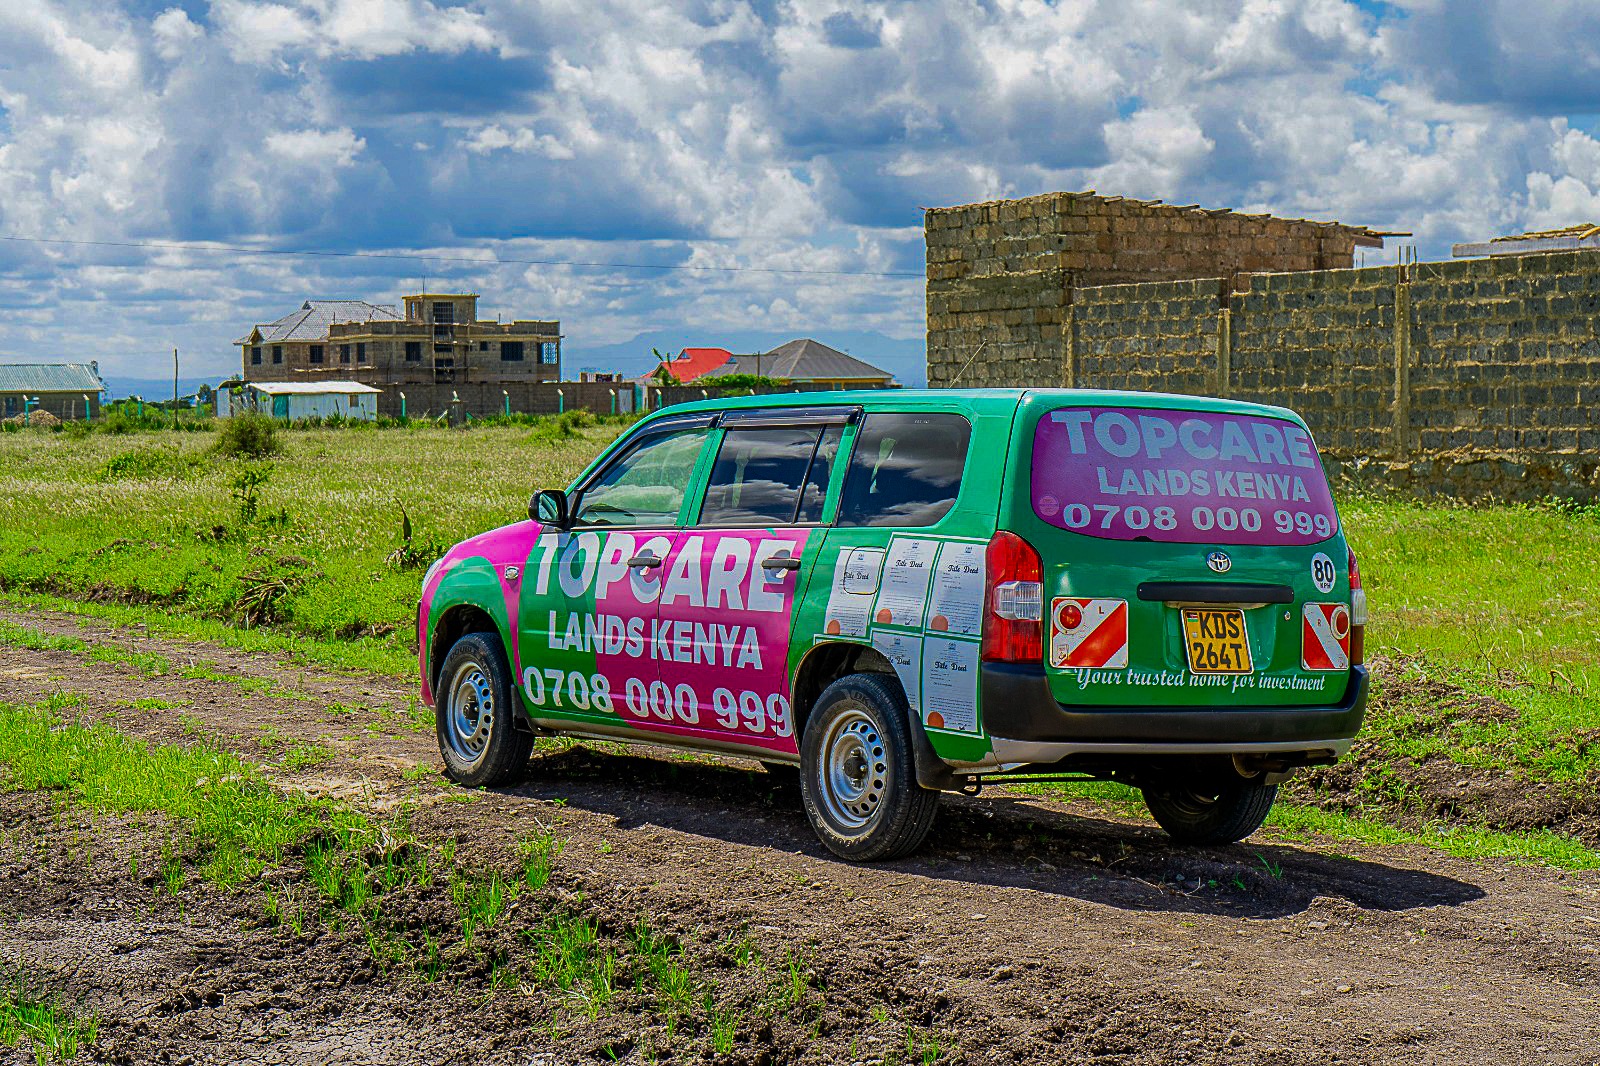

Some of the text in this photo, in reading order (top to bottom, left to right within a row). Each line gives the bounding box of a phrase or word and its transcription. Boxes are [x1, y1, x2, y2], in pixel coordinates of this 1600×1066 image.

[1050, 410, 1315, 469] TOPCARE
[1096, 466, 1311, 503] LANDS KENYA
[1063, 503, 1178, 530] 0708
[1191, 507, 1262, 532] 000
[1273, 510, 1331, 537] 999
[535, 531, 797, 613] TOPCARE
[1313, 559, 1334, 583] 80
[548, 610, 763, 670] LANDS KENYA
[1198, 612, 1241, 639] KDS
[1193, 642, 1243, 669] 264T
[1074, 668, 1122, 690] Your
[1126, 668, 1186, 687] trusted
[1231, 674, 1256, 694] for
[1258, 671, 1326, 691] investment
[523, 666, 615, 713] 0708
[625, 677, 699, 724] 000
[712, 687, 793, 738] 999
